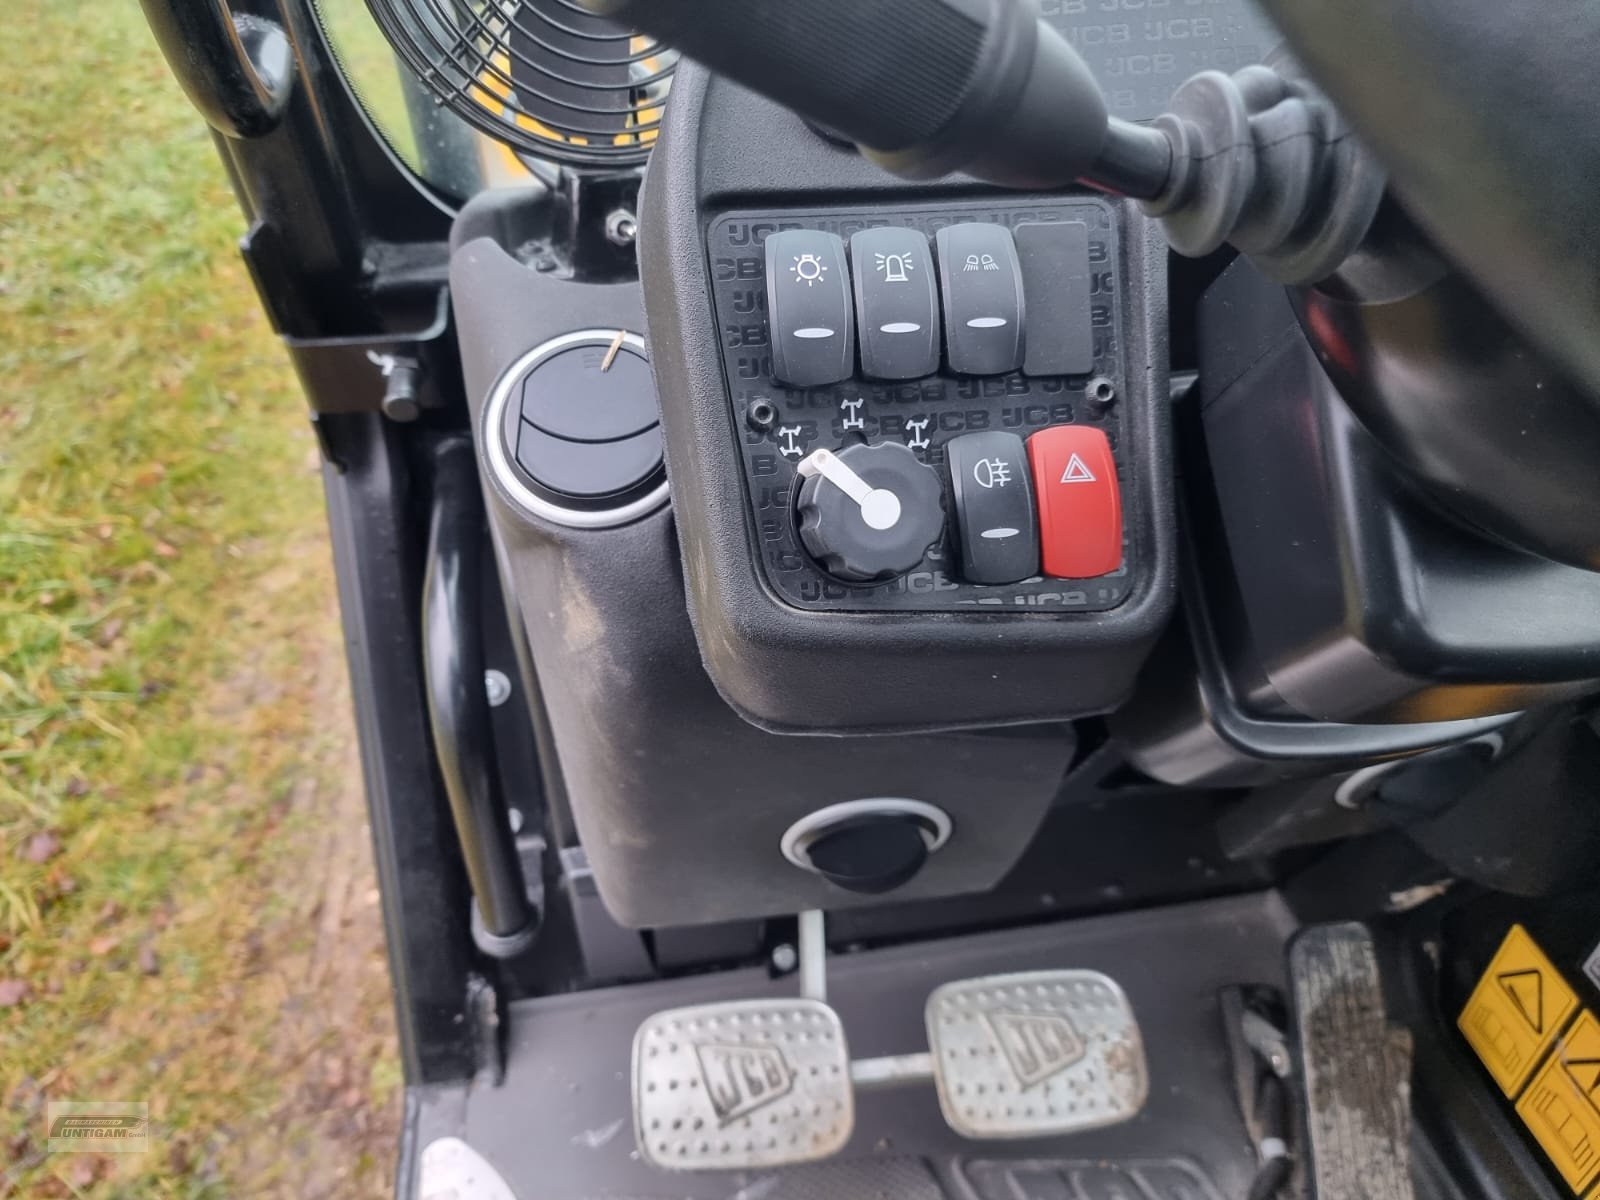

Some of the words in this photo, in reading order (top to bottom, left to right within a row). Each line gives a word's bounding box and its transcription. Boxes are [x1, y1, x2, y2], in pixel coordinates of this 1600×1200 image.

[1143, 18, 1215, 41] JCB
[1104, 54, 1177, 75] JCB
[957, 374, 1031, 399] JCB
[1002, 404, 1075, 428] JCB
